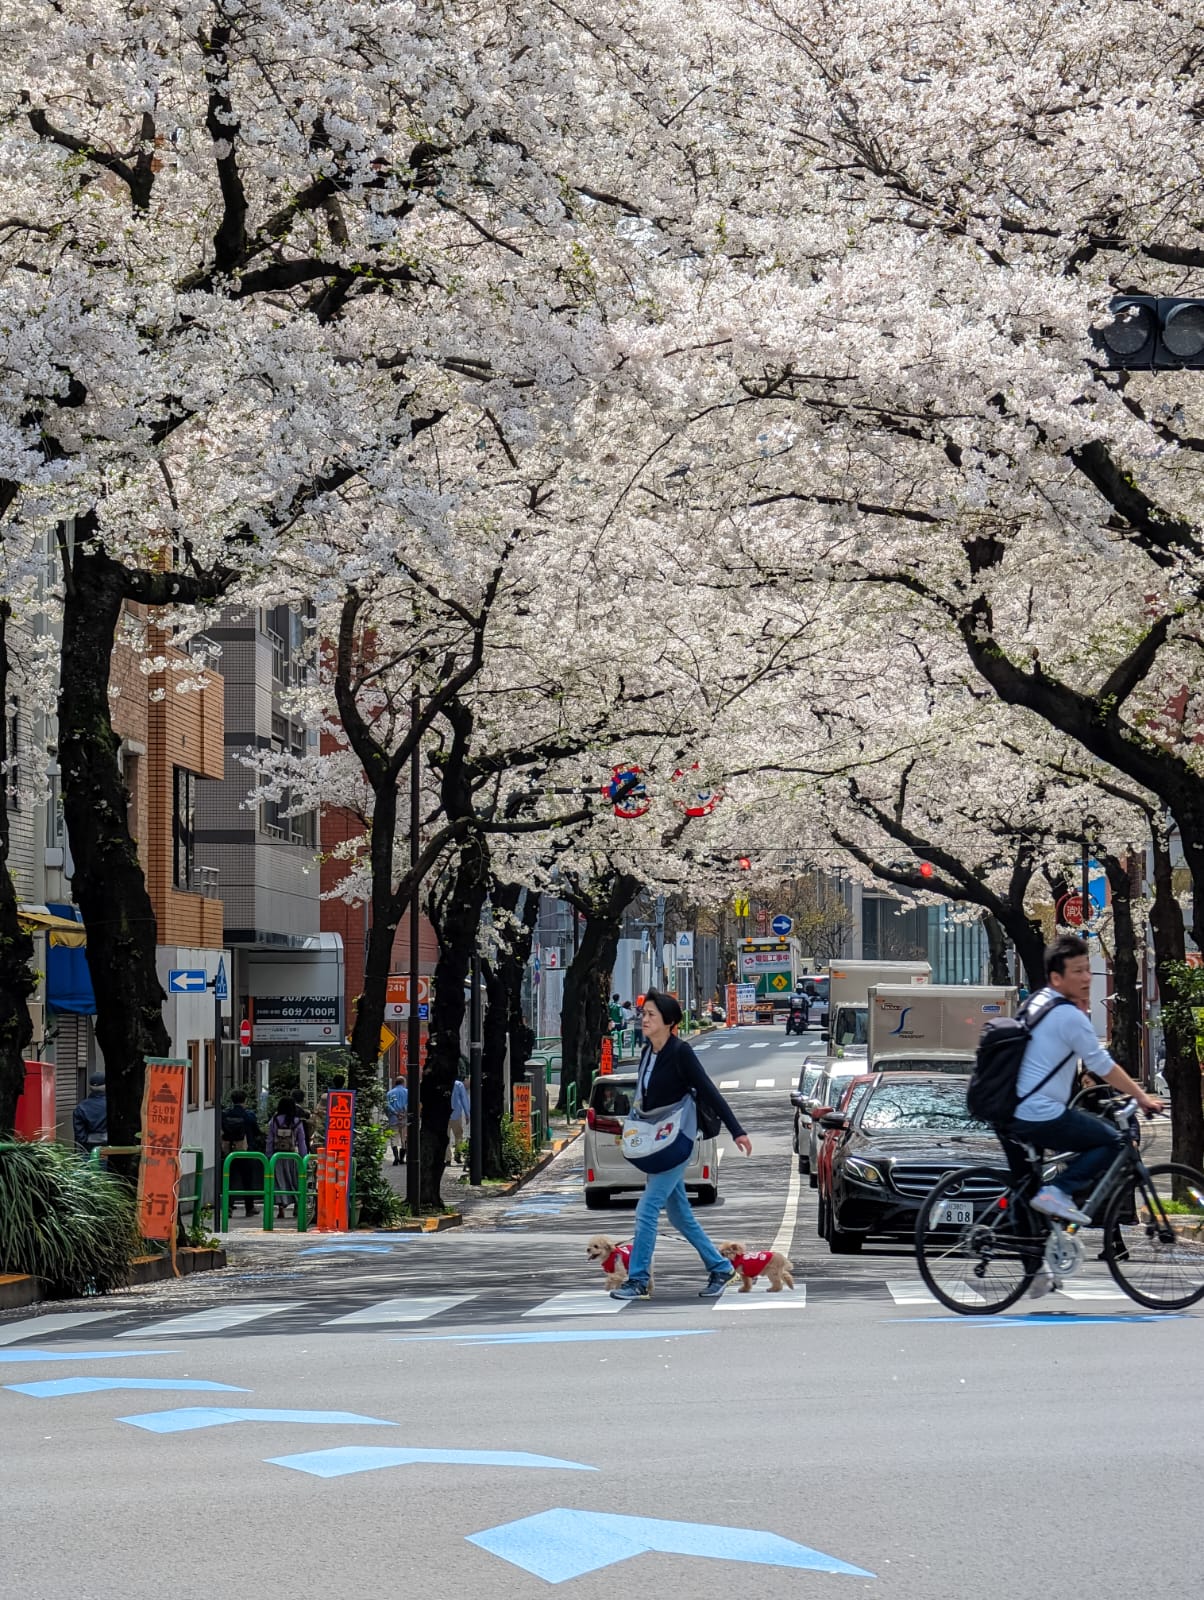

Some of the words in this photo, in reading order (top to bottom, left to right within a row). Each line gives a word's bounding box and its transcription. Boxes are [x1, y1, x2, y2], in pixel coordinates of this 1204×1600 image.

[152, 1105, 176, 1115] SLOW
[152, 1114, 175, 1125] DOWN
[328, 1118, 351, 1130] 200
